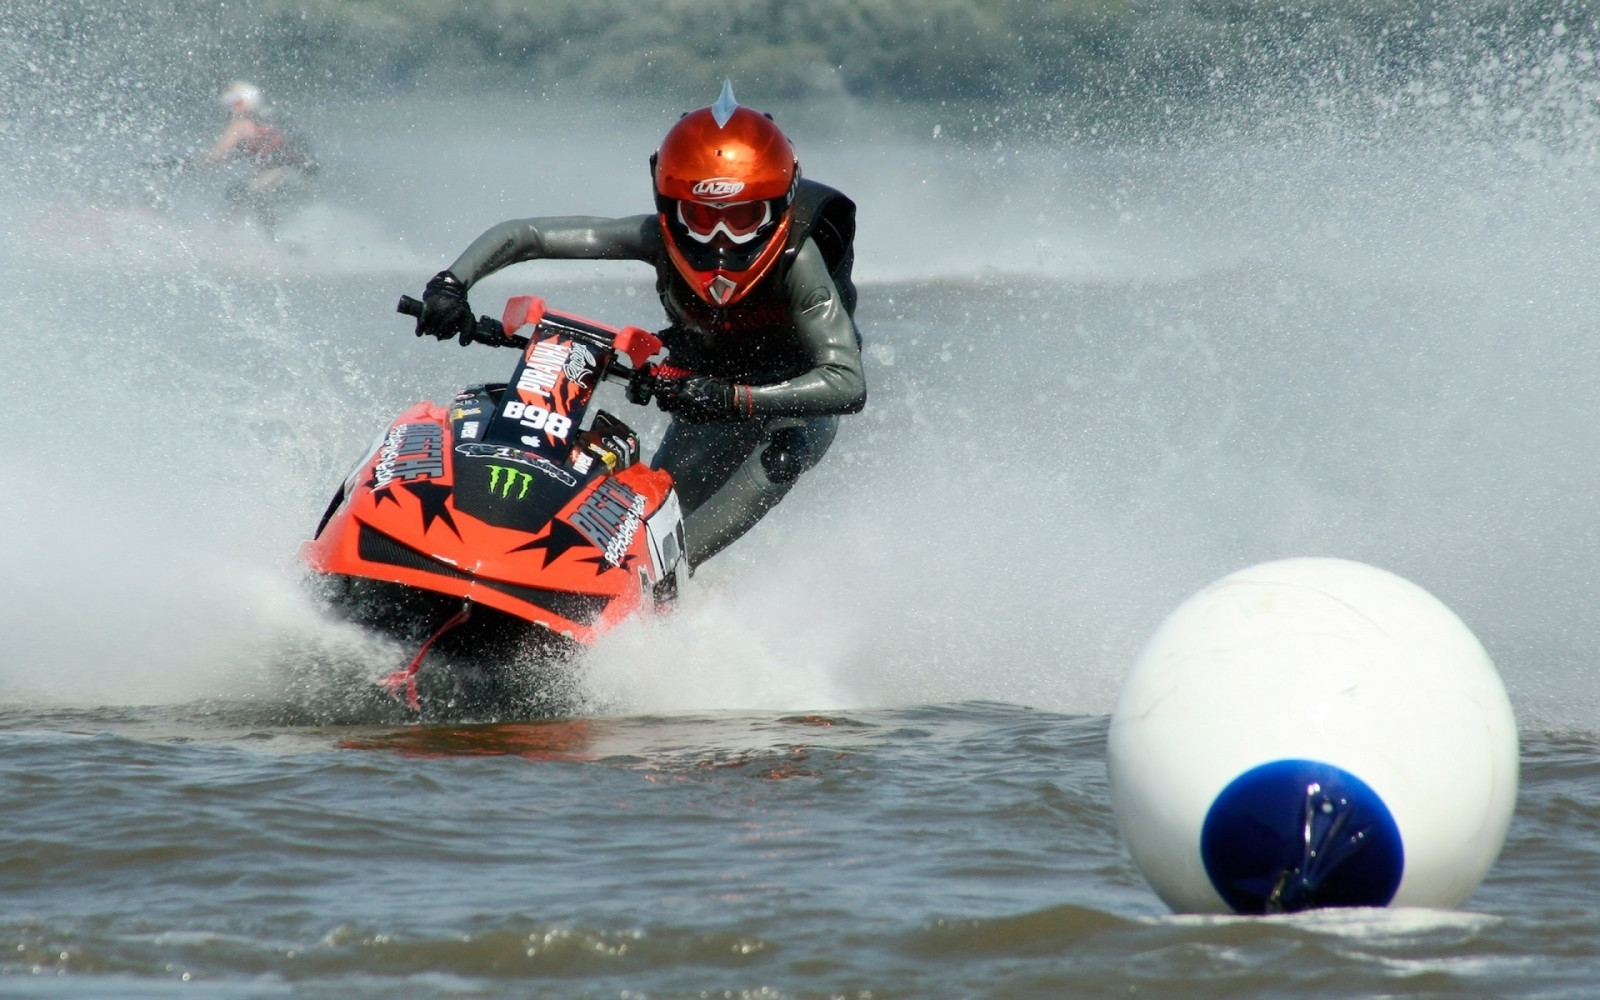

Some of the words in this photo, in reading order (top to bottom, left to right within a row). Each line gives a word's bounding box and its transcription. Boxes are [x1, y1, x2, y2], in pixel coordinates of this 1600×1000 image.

[697, 181, 742, 195] LAZER
[516, 341, 571, 398] PIRANHA
[502, 401, 572, 439] B98
